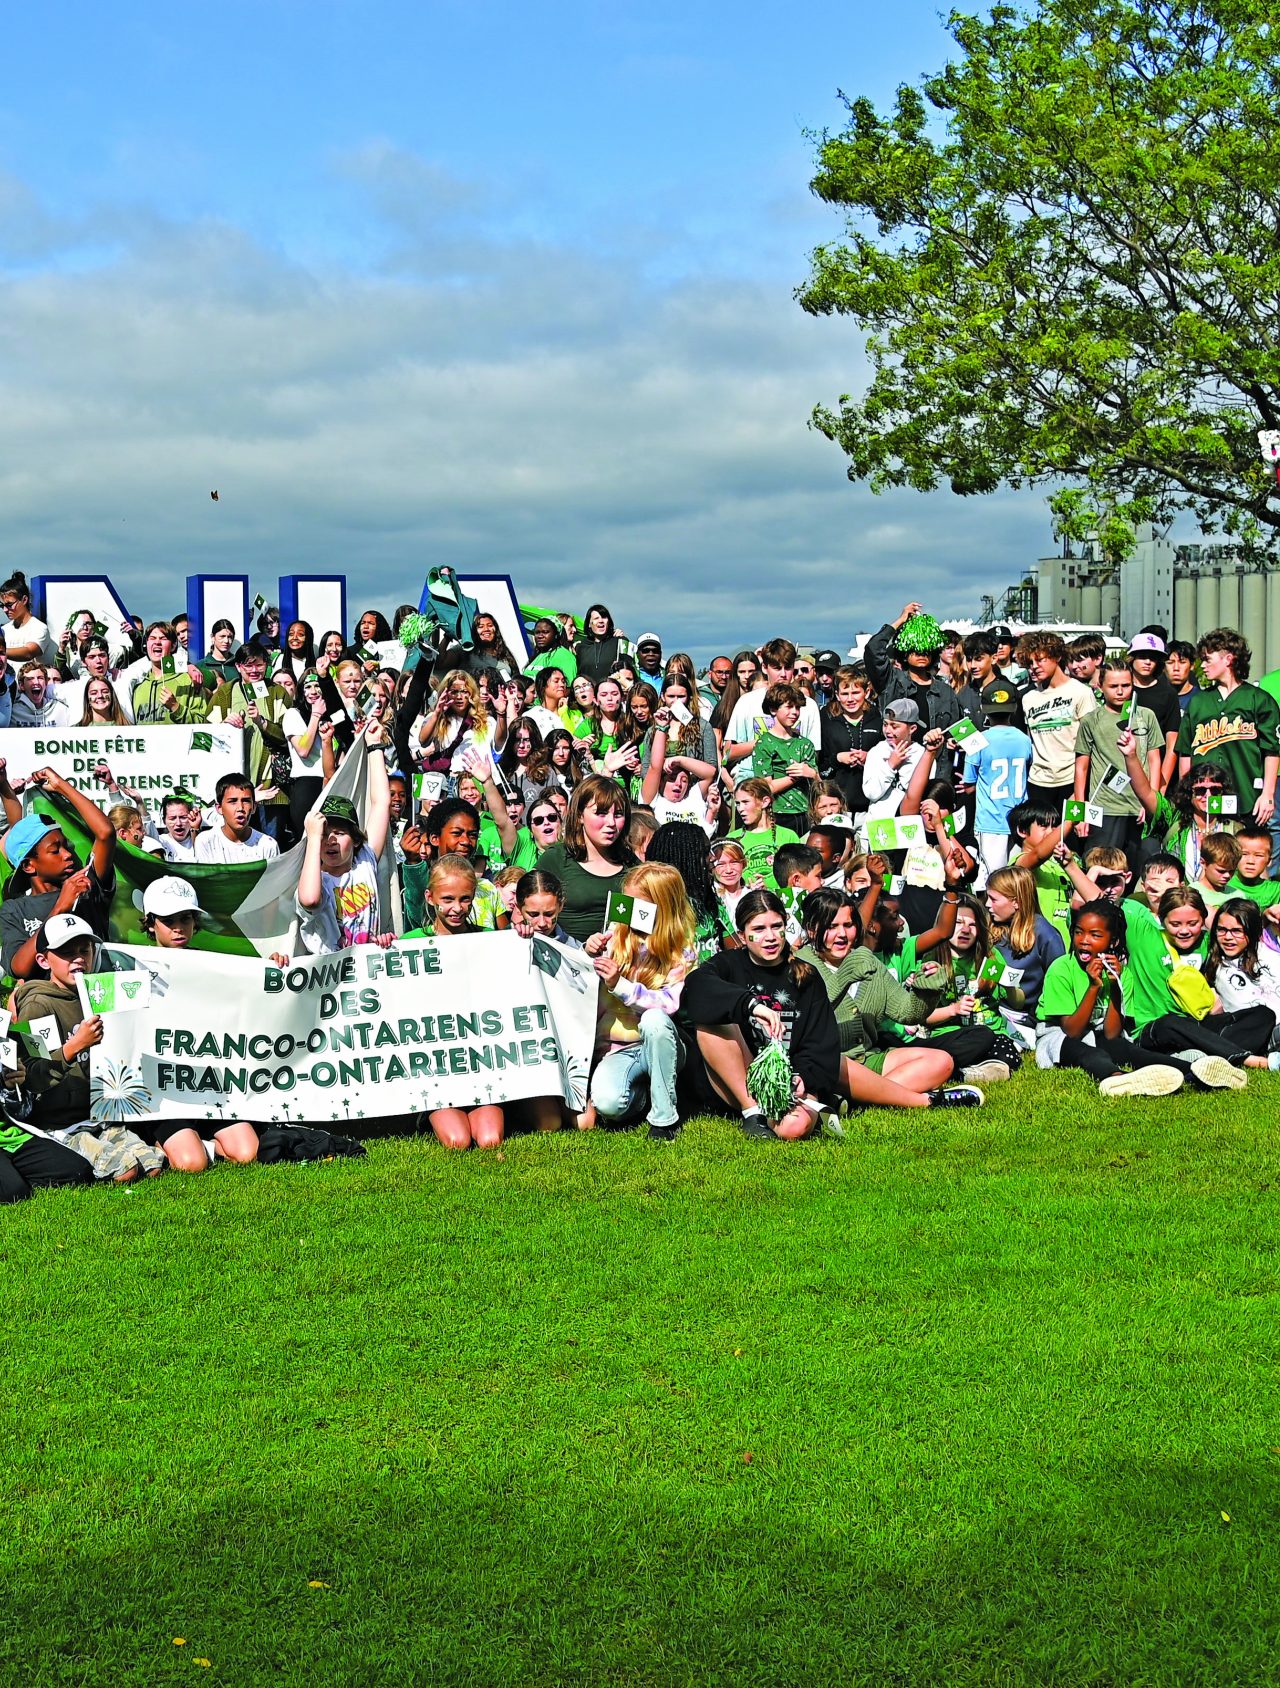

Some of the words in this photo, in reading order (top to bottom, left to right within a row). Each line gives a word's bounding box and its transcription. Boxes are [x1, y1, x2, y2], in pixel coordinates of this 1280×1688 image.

[34, 739, 100, 755] BONNE
[104, 734, 146, 754] FÊTE
[1191, 715, 1256, 748] Athletics
[179, 773, 200, 788] ET
[263, 956, 357, 994] BONNE
[320, 988, 381, 1020] DES
[155, 1010, 504, 1062] FRANCO-ONTARIENS
[512, 1004, 549, 1033] ET
[157, 1036, 560, 1095] FRANCO-ONTARIENNES
